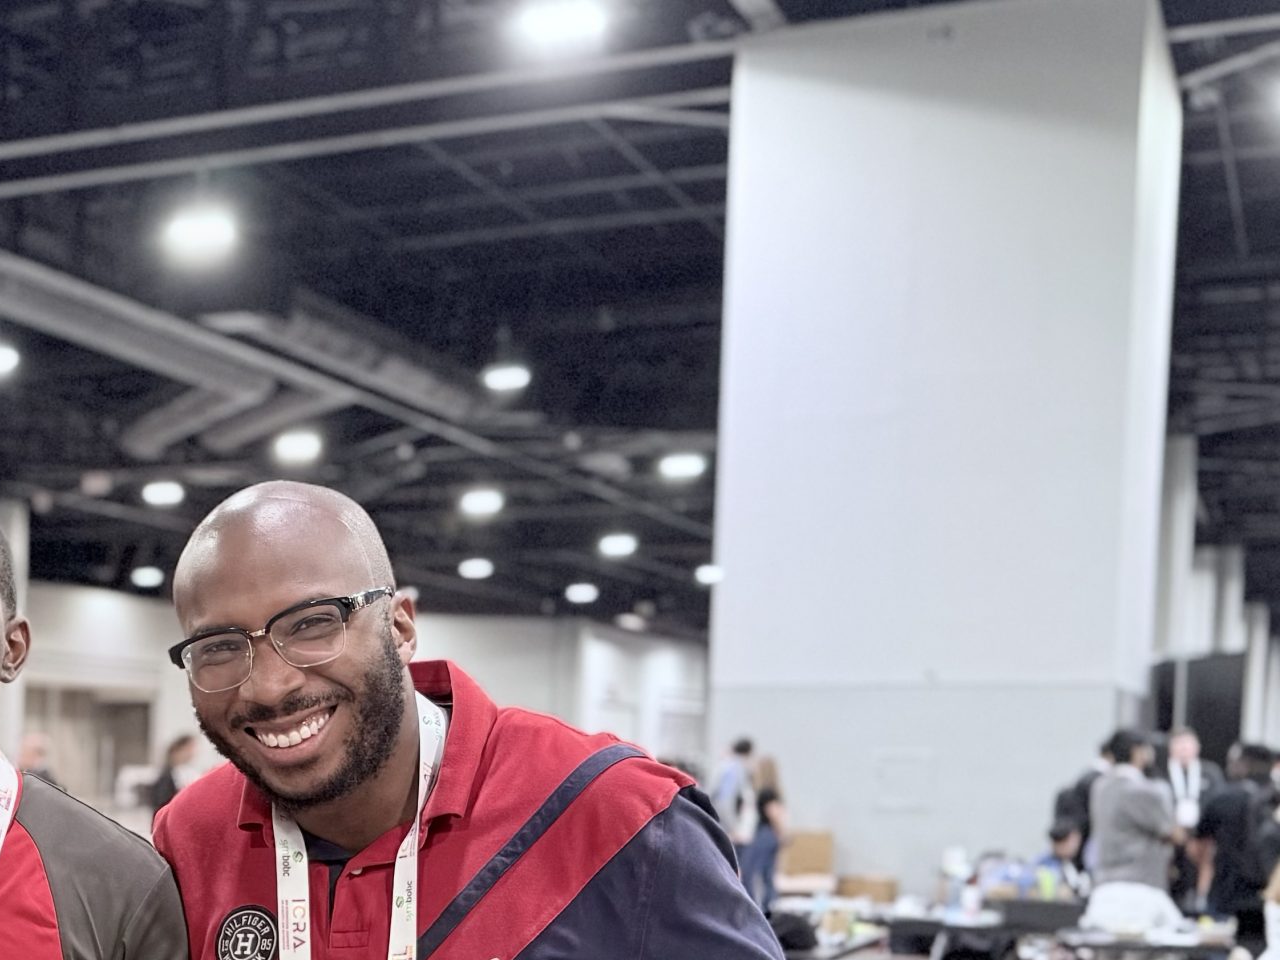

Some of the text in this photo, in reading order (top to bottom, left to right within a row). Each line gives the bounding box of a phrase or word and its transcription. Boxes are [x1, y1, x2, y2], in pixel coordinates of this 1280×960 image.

[279, 839, 291, 877] symbotic
[224, 914, 271, 937] HILFIGER
[292, 898, 306, 952] ICRA
[233, 933, 256, 955] H
[260, 938, 273, 951] 85
